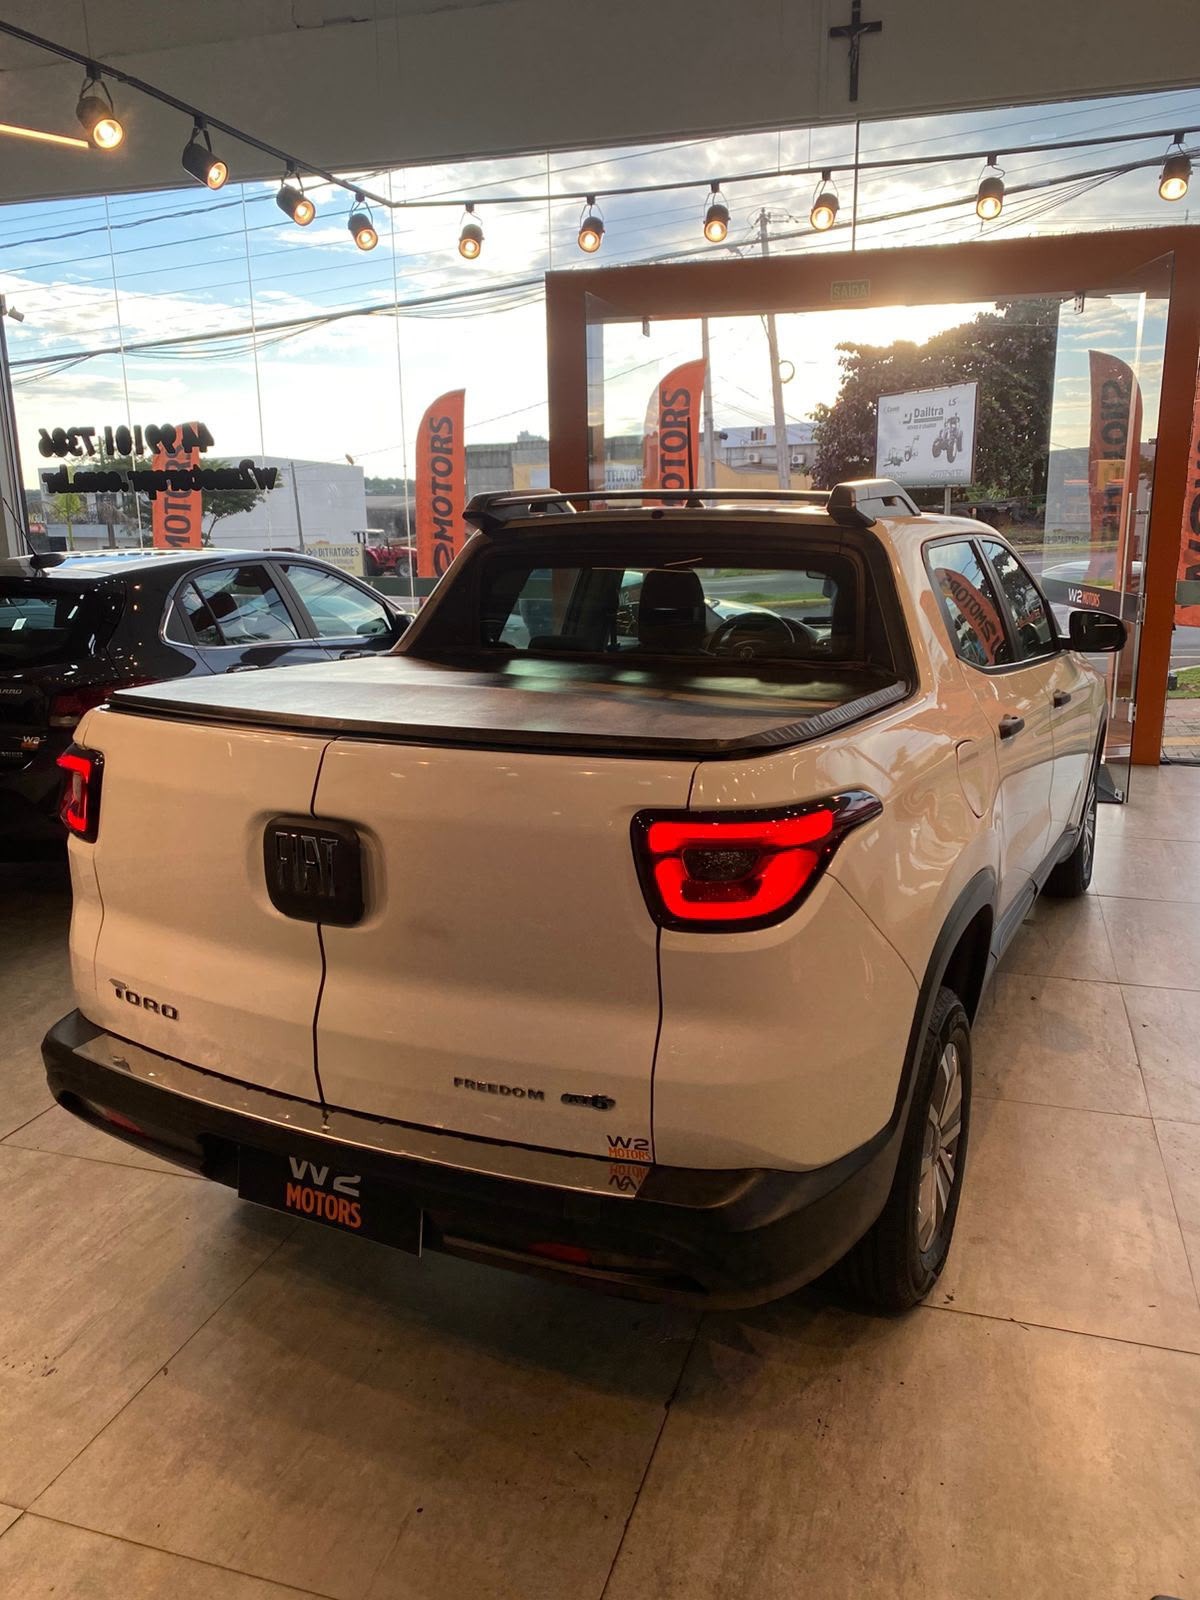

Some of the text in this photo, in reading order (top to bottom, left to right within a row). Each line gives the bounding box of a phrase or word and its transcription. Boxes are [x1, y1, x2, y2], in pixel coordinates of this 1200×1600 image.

[661, 387, 692, 506] OTORS
[429, 415, 454, 542] MOTORS
[1069, 588, 1083, 603] W2
[275, 831, 339, 897] FIAT
[109, 978, 179, 1021] TORO
[453, 1076, 546, 1101] FREEDOM
[607, 1135, 649, 1151] W2
[608, 1147, 652, 1160] MOTORS
[289, 1155, 361, 1197] W2
[286, 1182, 362, 1229] MOTORS
